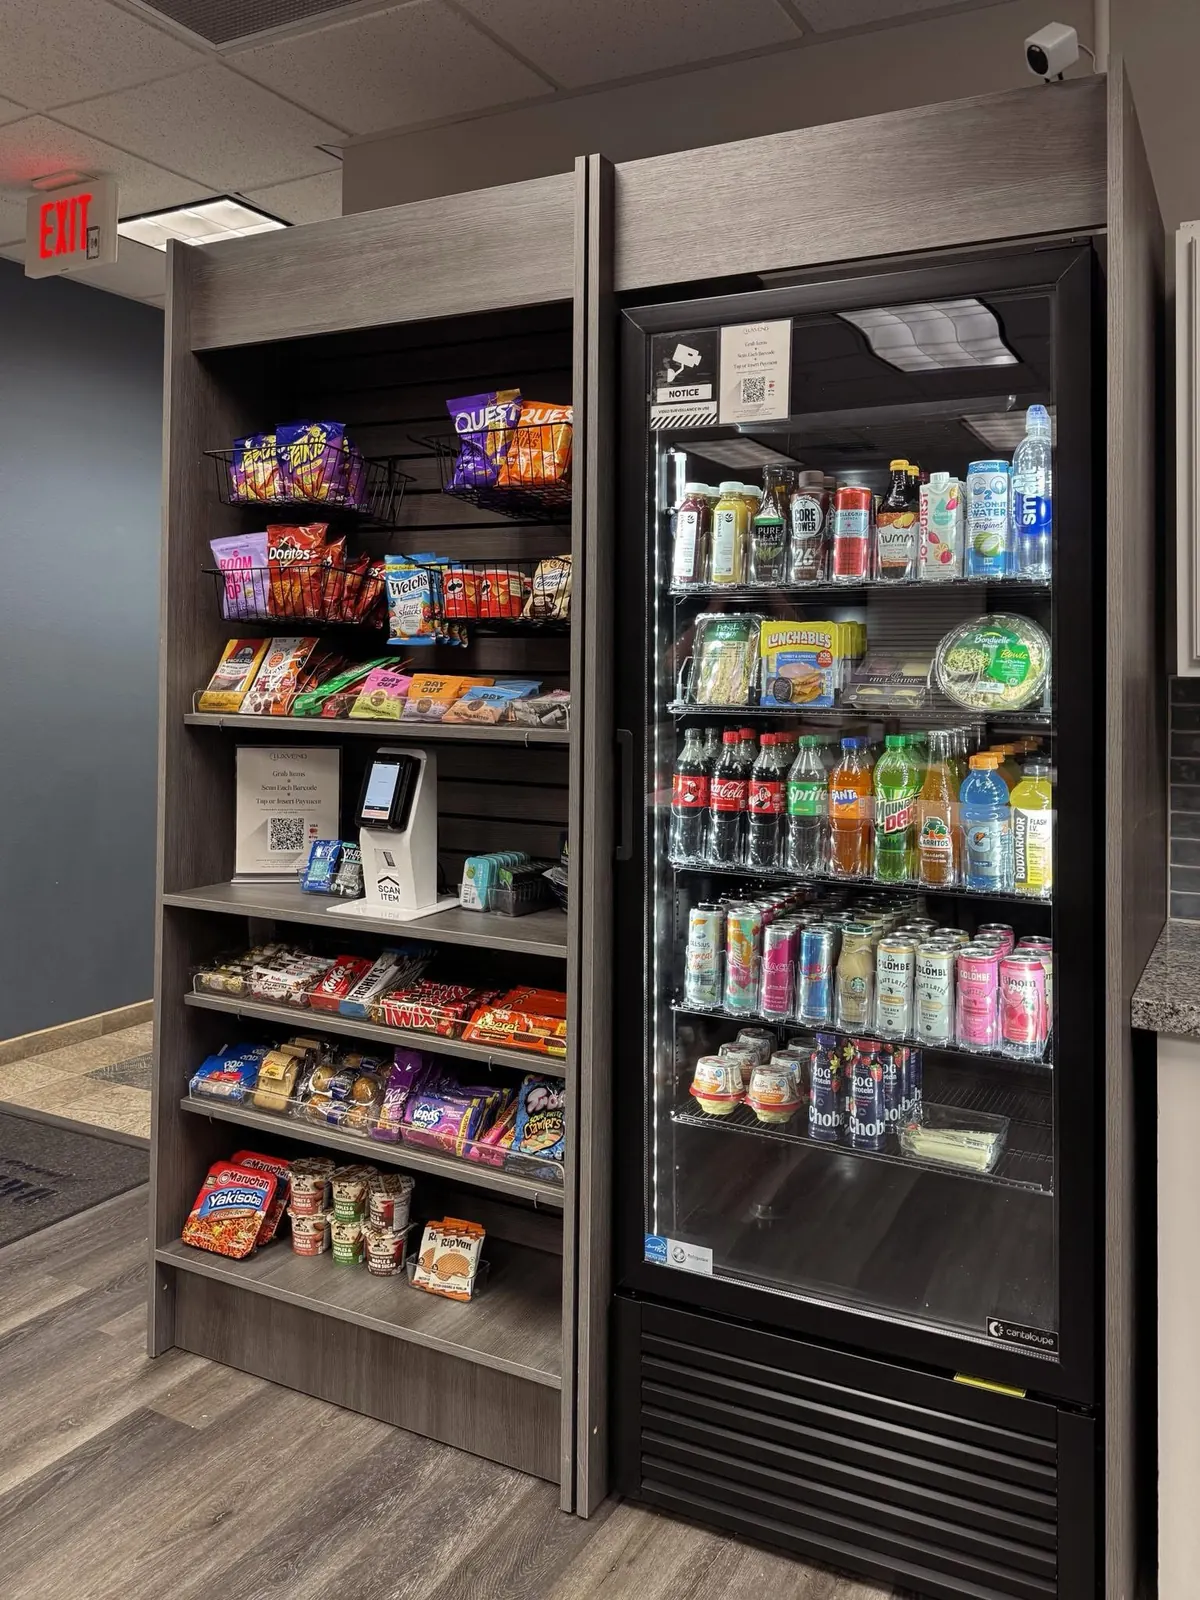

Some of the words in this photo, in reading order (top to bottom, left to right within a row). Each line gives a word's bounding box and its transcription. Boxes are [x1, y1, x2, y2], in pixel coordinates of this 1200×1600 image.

[40, 193, 92, 259] EXIT
[669, 388, 699, 398] NOTICE
[455, 404, 520, 433] QUEST
[519, 408, 573, 425] QUES
[795, 509, 815, 521] CORE
[795, 522, 816, 531] POWER
[268, 547, 310, 560] Doritos
[220, 556, 252, 570] BOOM
[227, 584, 241, 599] OP
[391, 574, 428, 595] Welch's
[768, 631, 831, 648] LUNCHABLES
[975, 634, 1010, 644] Bonduelle
[296, 798, 321, 806] Payment
[789, 786, 827, 804] Sprite
[831, 789, 859, 800] FANTA
[1016, 817, 1025, 879] BODYARMOR
[378, 885, 400, 895] SCAN
[380, 893, 399, 902] ITEM
[883, 1064, 896, 1074] 0G
[809, 1105, 844, 1127] Choba
[849, 1116, 885, 1136] Chob
[252, 1160, 290, 1179] Maruchan
[230, 1172, 269, 1189] Maruchan
[209, 1190, 262, 1208] Yakisoba
[441, 1239, 455, 1248] Rip
[455, 1239, 472, 1251] Van
[1006, 1329, 1054, 1345] cantaloupe
